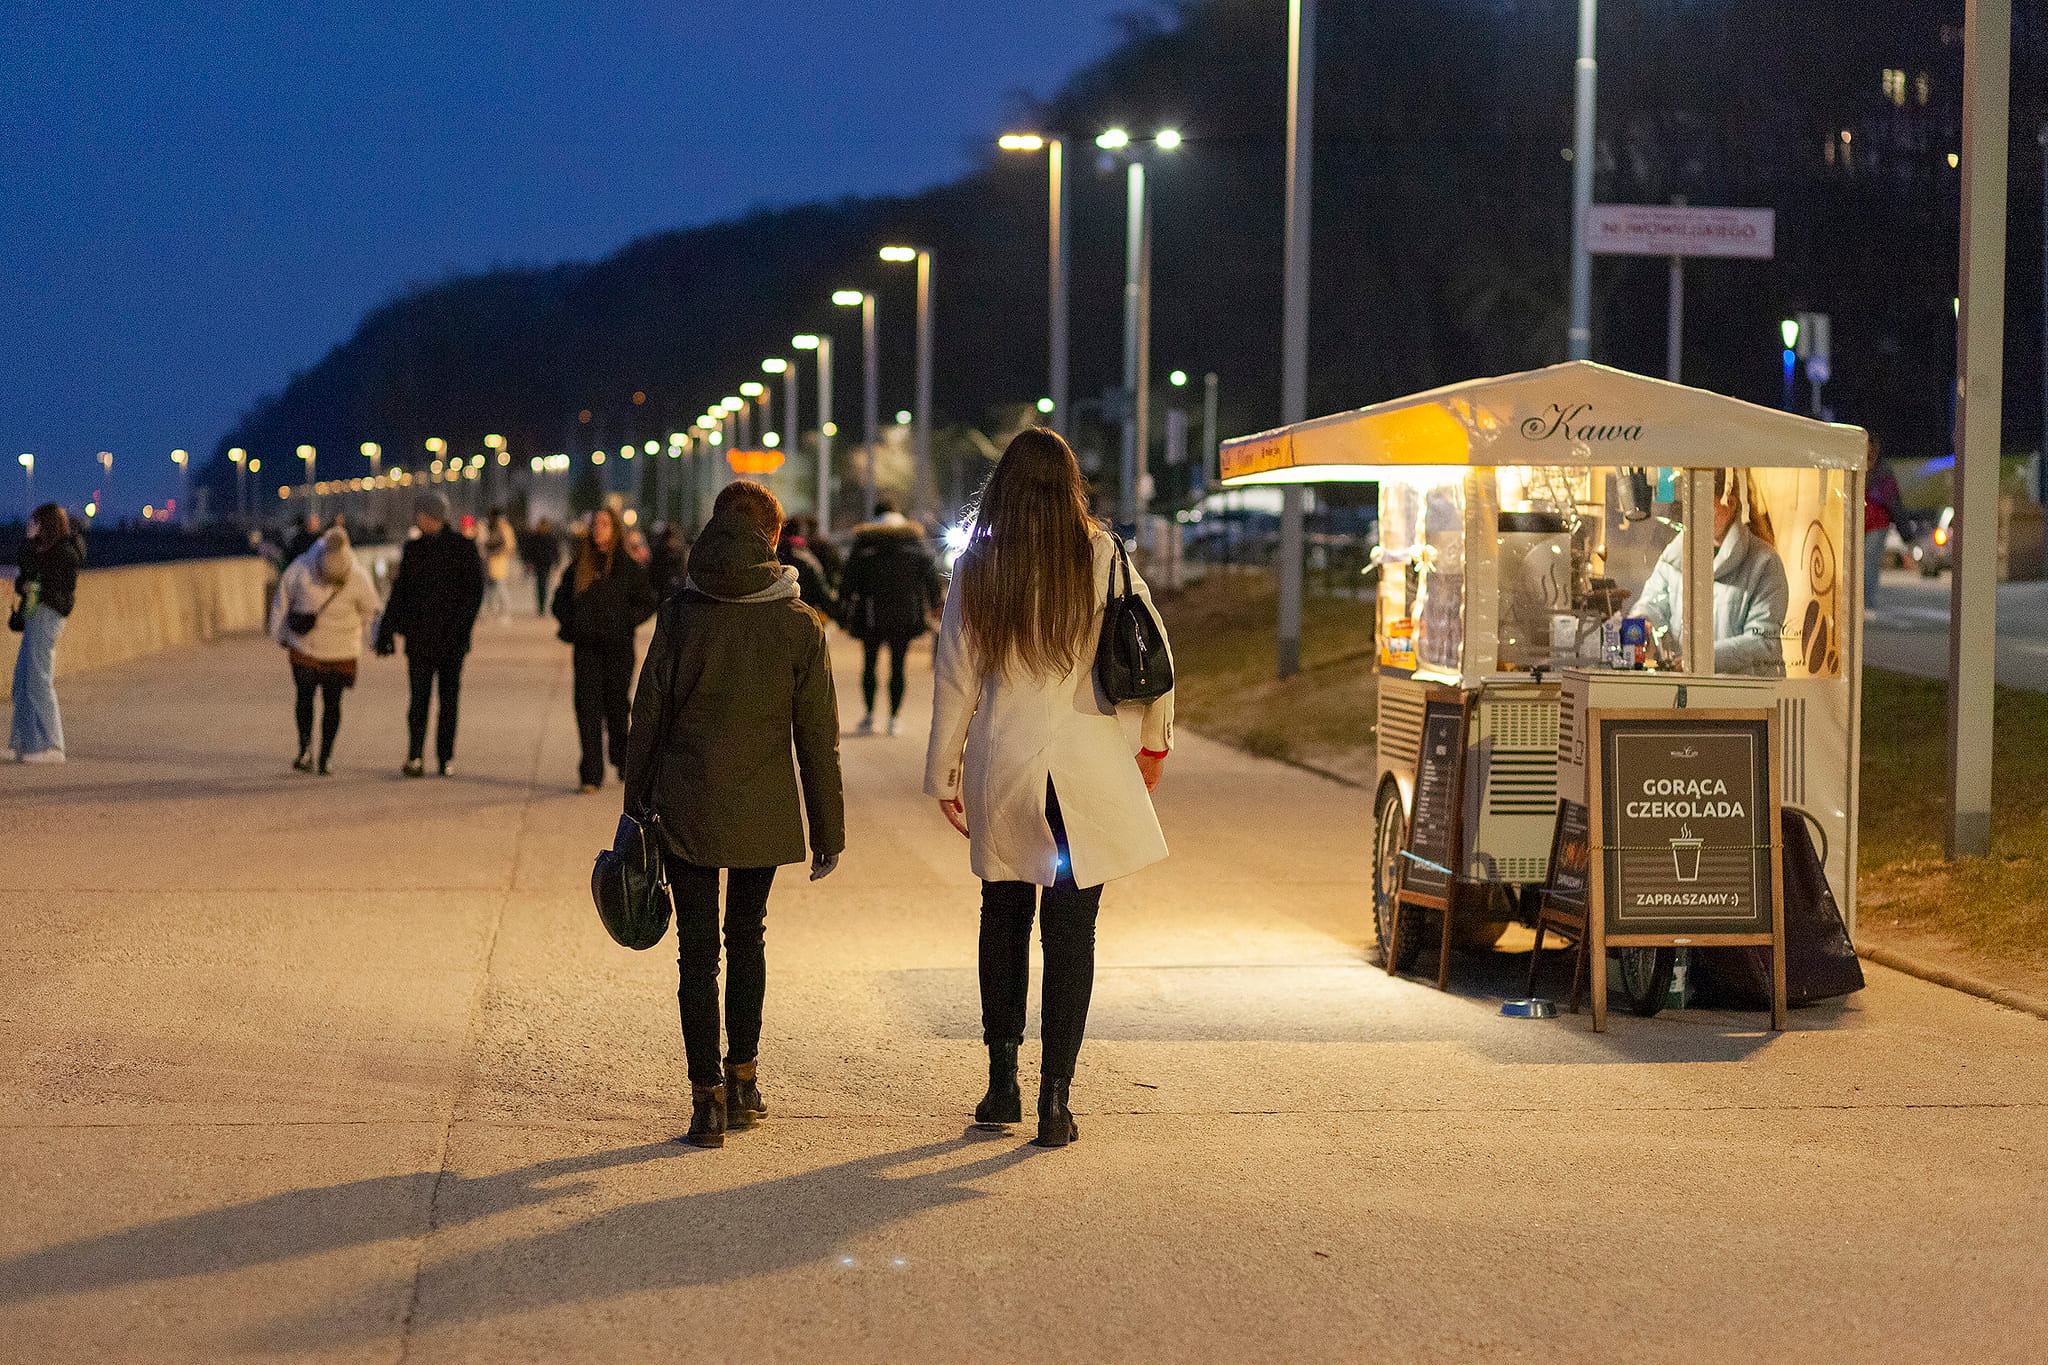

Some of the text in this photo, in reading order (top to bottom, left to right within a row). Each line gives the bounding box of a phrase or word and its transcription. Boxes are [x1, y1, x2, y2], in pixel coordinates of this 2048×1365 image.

[1520, 403, 1645, 441] Kawa
[1642, 778, 1727, 800] GORĄCA
[1625, 801, 1746, 818] CZEKOLADA
[1636, 893, 1727, 906] ZAPRASZAMY
